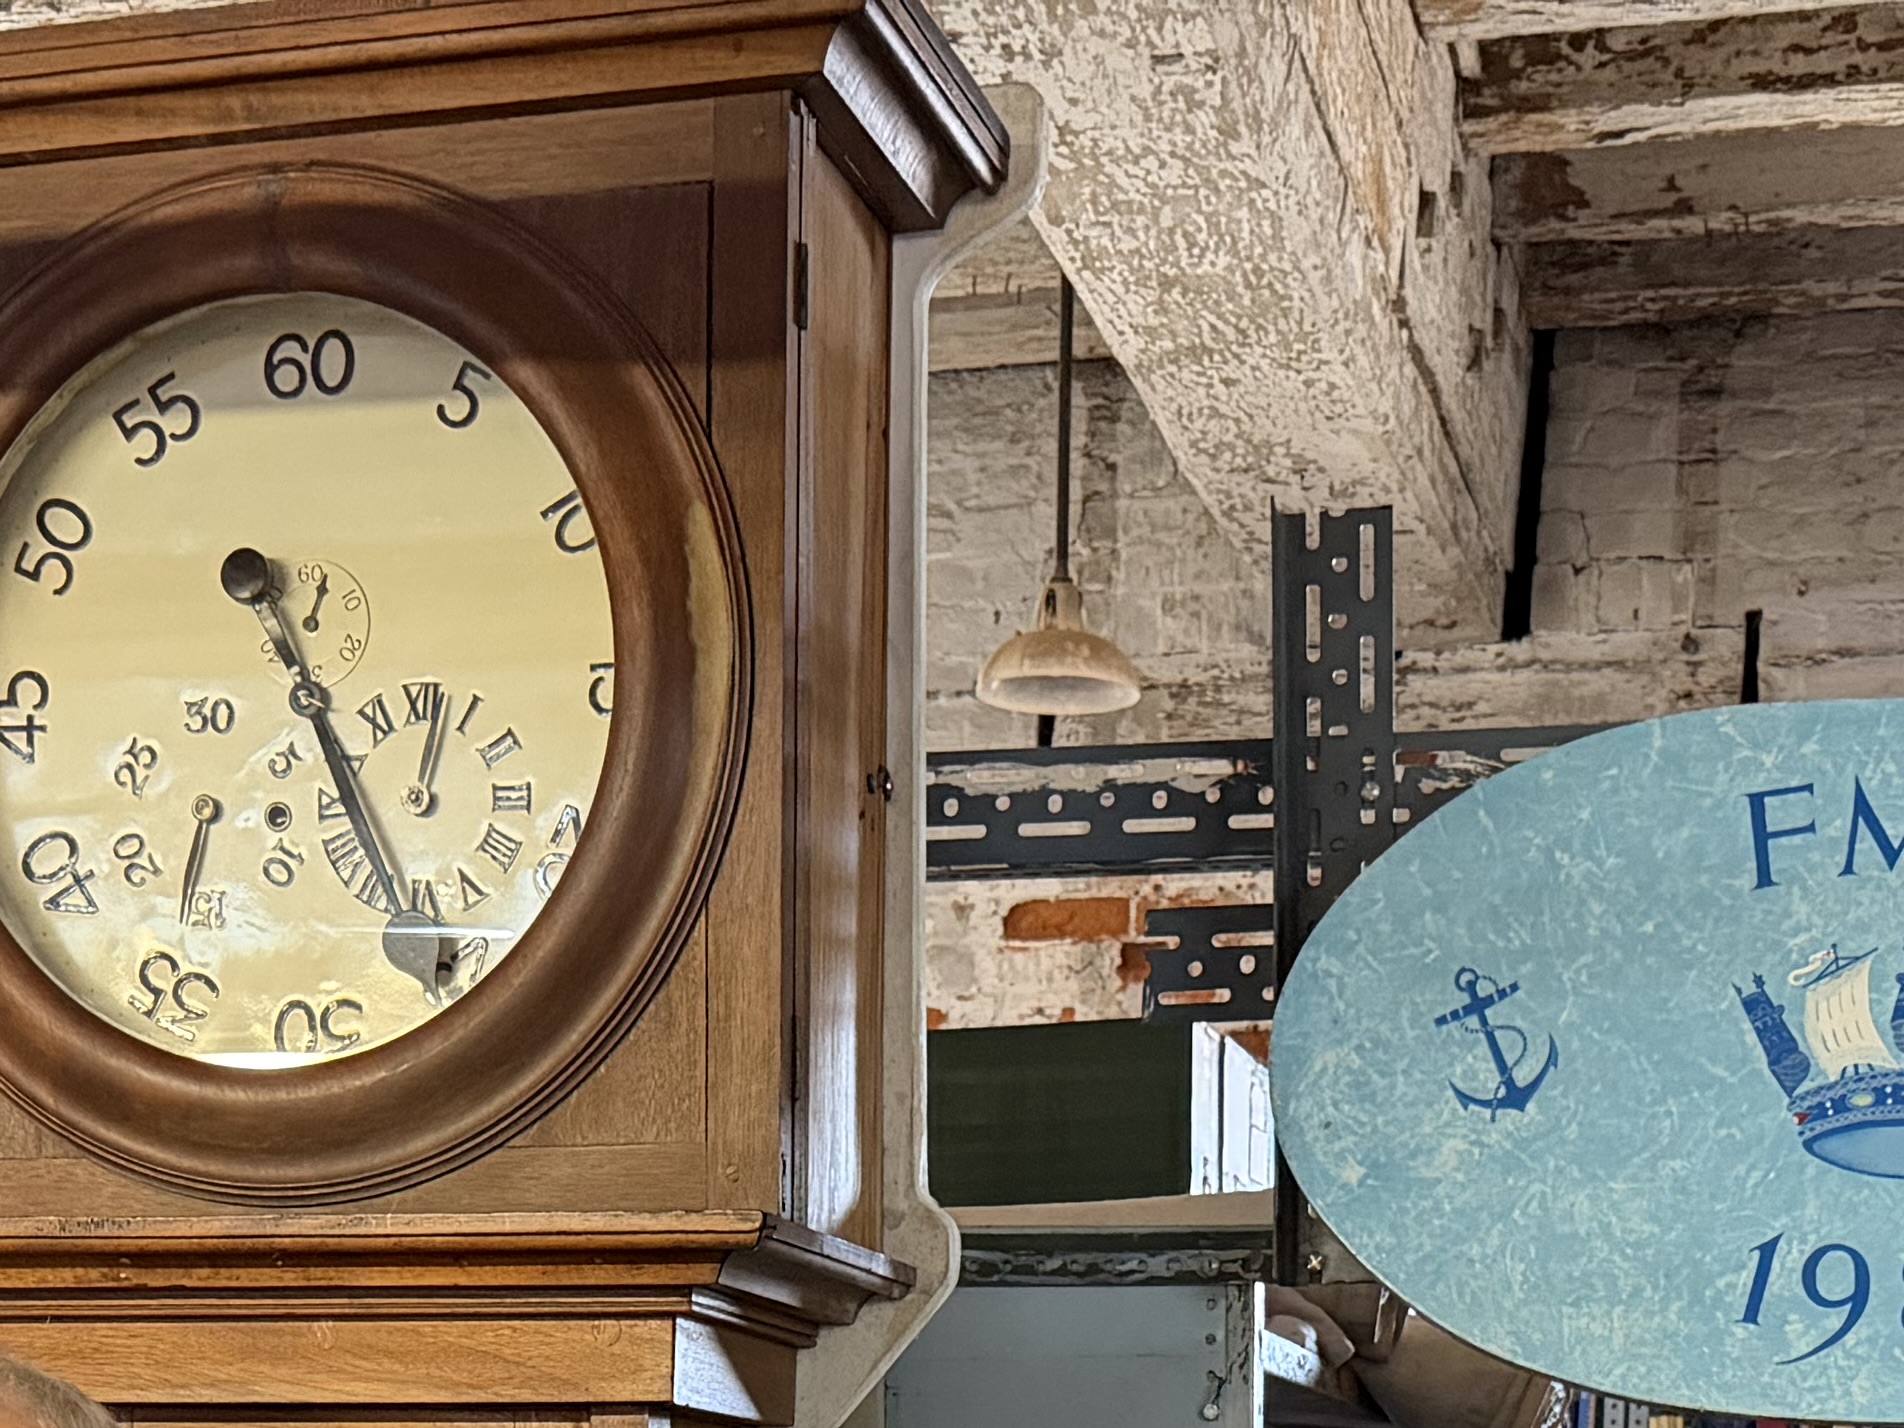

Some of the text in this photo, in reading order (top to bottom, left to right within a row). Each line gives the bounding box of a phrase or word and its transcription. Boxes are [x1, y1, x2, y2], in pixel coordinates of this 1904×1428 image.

[264, 328, 355, 399] 60
[437, 362, 492, 427] 5
[112, 373, 202, 466] 55
[15, 498, 92, 595] 50
[298, 564, 323, 583] 60
[342, 589, 361, 611] 10
[340, 634, 362, 662] 20
[184, 697, 235, 734] 30
[356, 693, 397, 748] XI
[402, 682, 443, 728] XII
[456, 694, 484, 736] I
[114, 737, 158, 800] 25
[268, 741, 303, 779] 5
[476, 727, 522, 770] II
[492, 781, 530, 814] III
[21, 831, 100, 916] 40
[113, 834, 163, 888] 20
[263, 838, 304, 887] 10
[191, 890, 226, 931] 15
[458, 868, 490, 911] V
[128, 950, 219, 1043] 35
[277, 998, 363, 1054] 30
